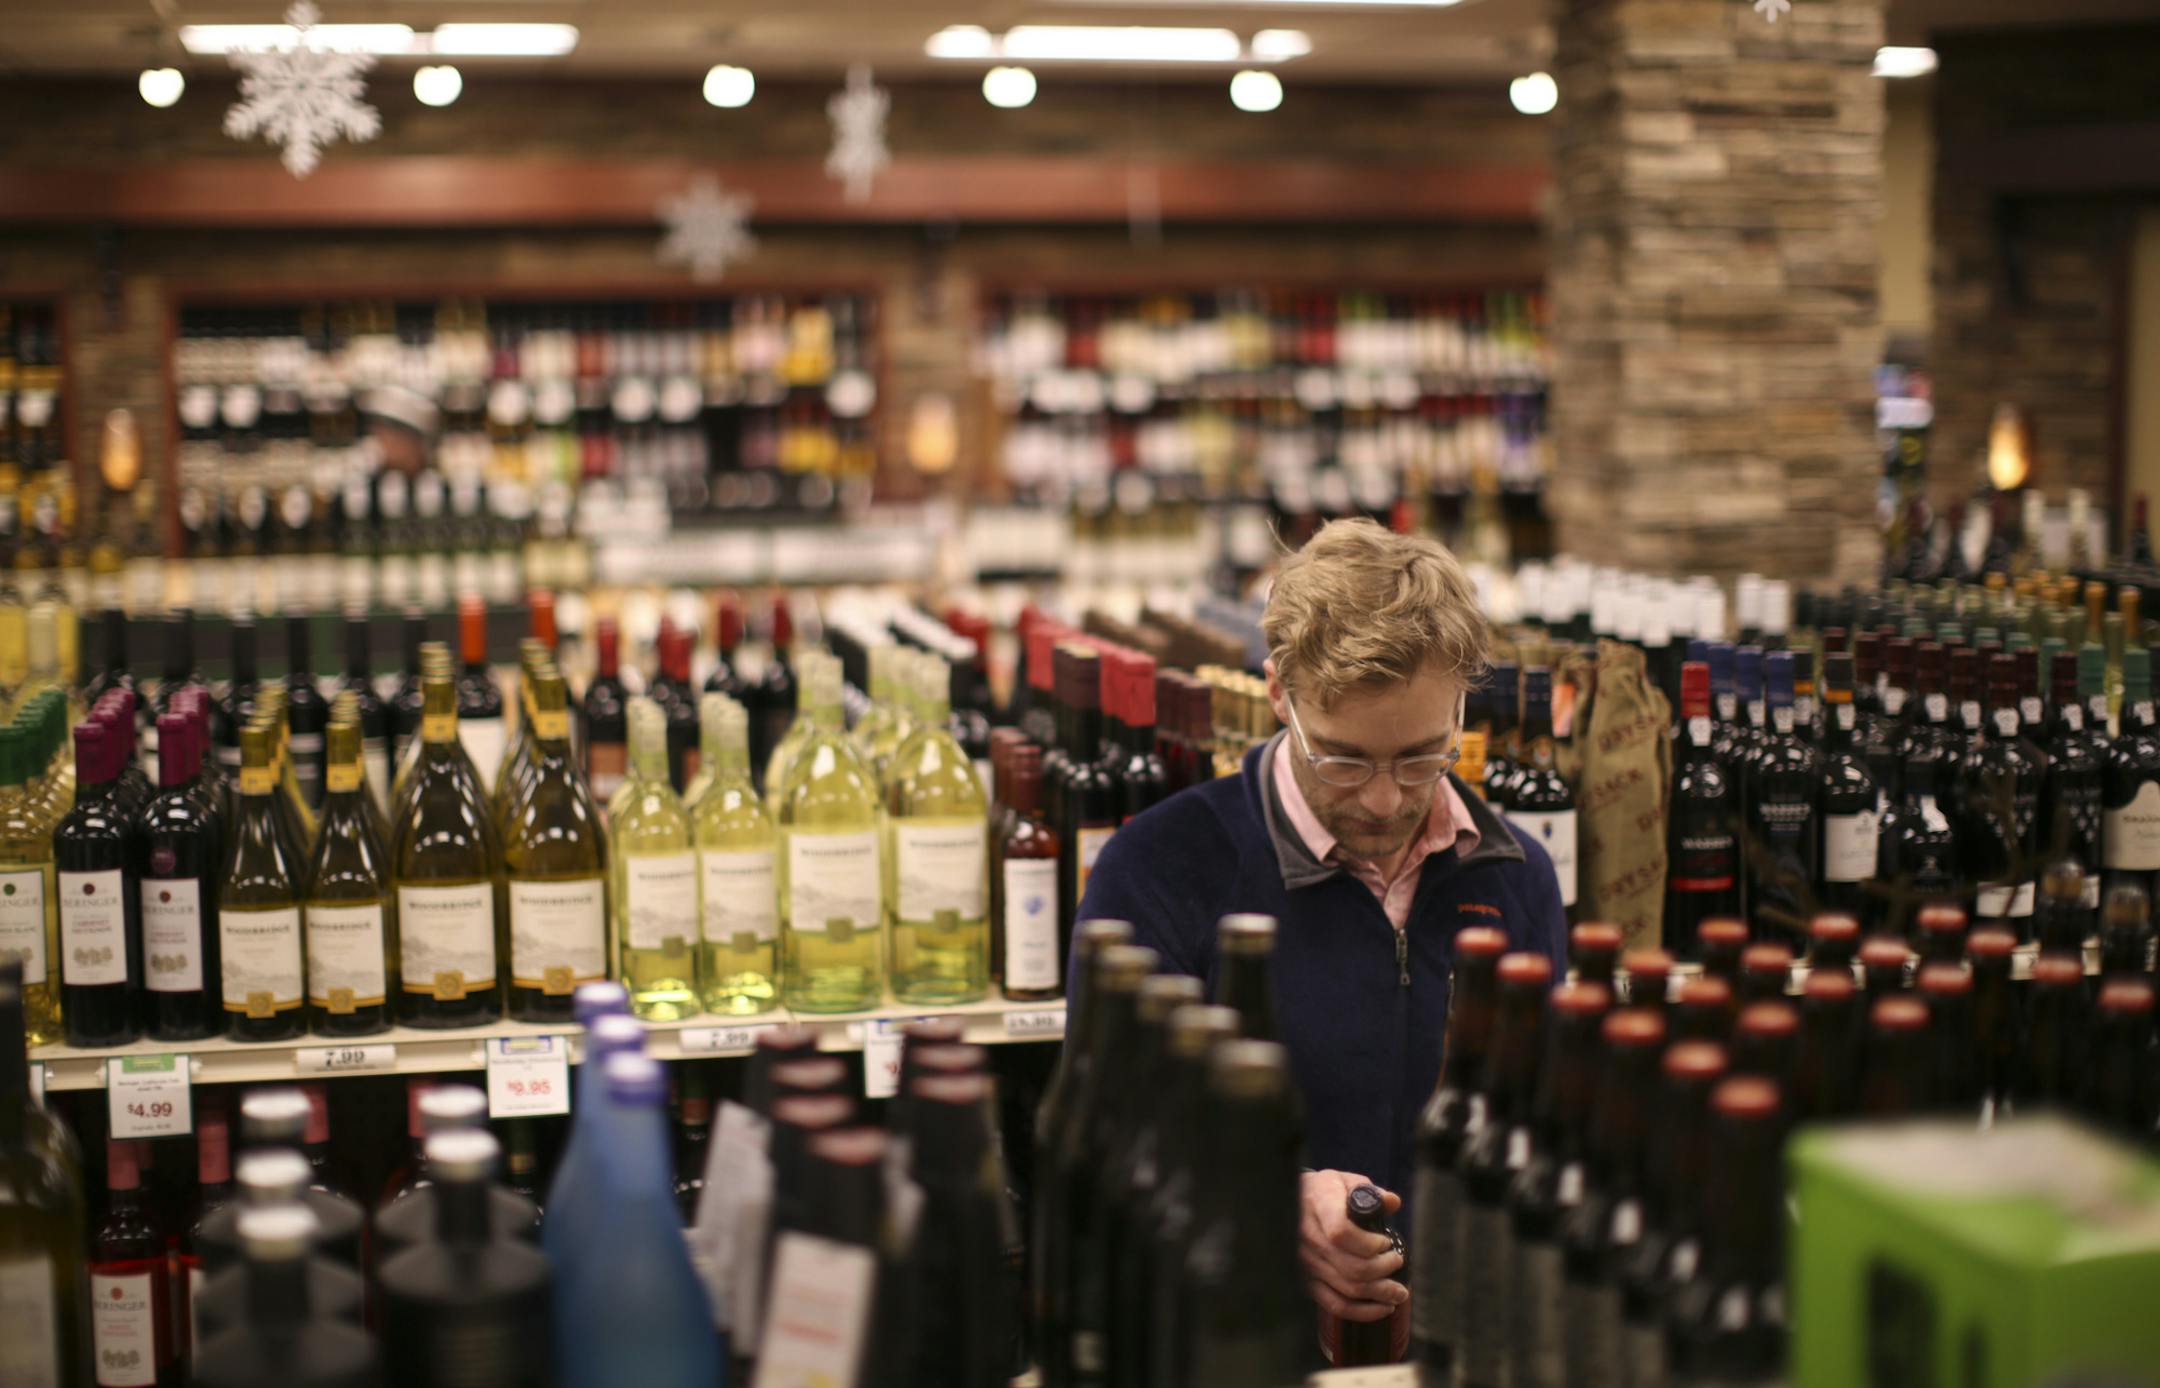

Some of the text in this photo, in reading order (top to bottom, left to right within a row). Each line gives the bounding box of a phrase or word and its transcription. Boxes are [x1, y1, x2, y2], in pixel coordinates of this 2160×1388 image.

[408, 899, 482, 911] WOODBRIDGE
[226, 924, 290, 935] WOODBRIDGE
[325, 1049, 365, 1068] 7.99
[127, 1101, 173, 1118] $4.99
